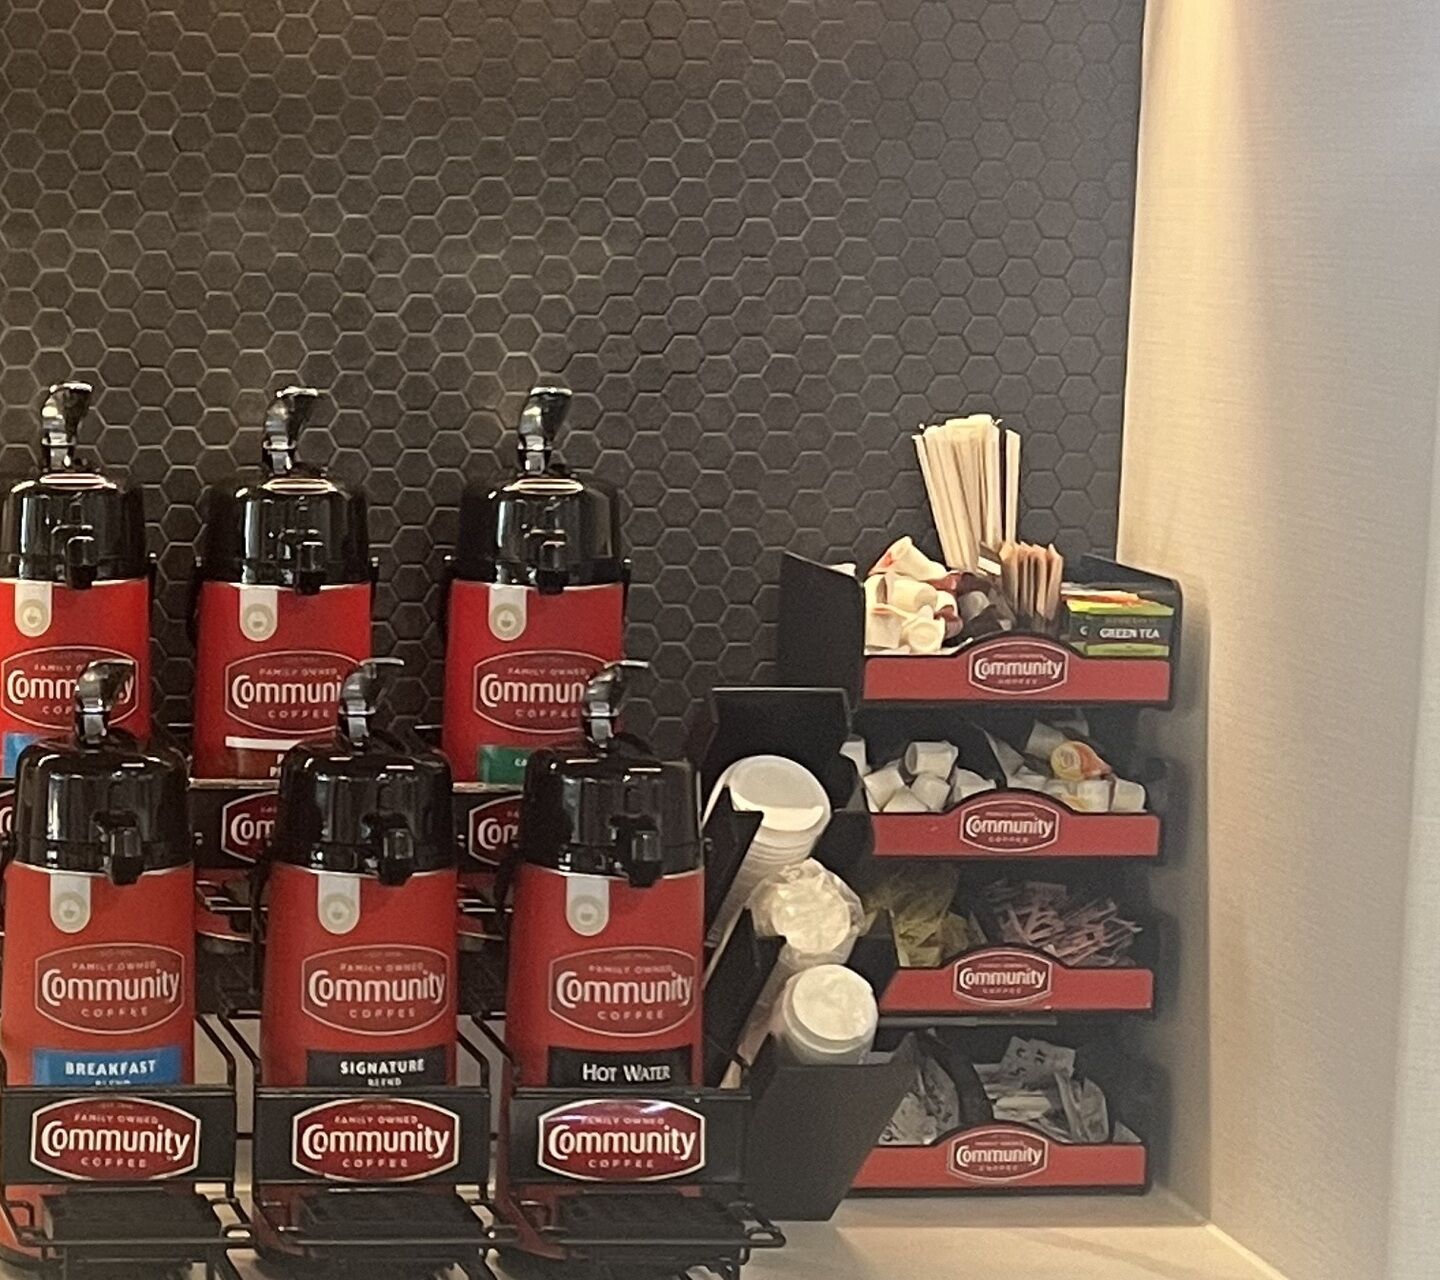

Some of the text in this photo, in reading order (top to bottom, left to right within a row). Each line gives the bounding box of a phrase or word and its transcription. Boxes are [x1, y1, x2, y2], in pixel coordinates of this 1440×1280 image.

[1099, 628, 1137, 639] GREEN
[1139, 628, 1160, 639] TEA
[974, 656, 1064, 680] Community
[7, 670, 135, 705] Commy
[231, 674, 343, 709] Communi
[480, 673, 586, 707] Commun
[965, 815, 1054, 838] Community
[41, 968, 181, 1006] Community
[308, 969, 446, 1007] Community
[556, 970, 694, 1009] Community
[959, 967, 1047, 990] Community
[81, 1006, 148, 1018] COFFEE
[348, 1007, 416, 1019] COFFEE
[597, 1009, 665, 1020] COFFEE
[64, 1059, 157, 1076] BREAKFAST
[340, 1058, 425, 1075] SIGNATURE
[73, 1113, 159, 1124] FAMILY OWNED
[334, 1115, 418, 1124] FAMILY OWNED
[41, 1120, 191, 1161] Community
[302, 1123, 450, 1160] Community
[548, 1124, 696, 1160] Community
[80, 1156, 147, 1168] COFFEE
[341, 1158, 409, 1168] COFFEE
[588, 1158, 655, 1169] COFFEE
[956, 1145, 1043, 1167] Community
